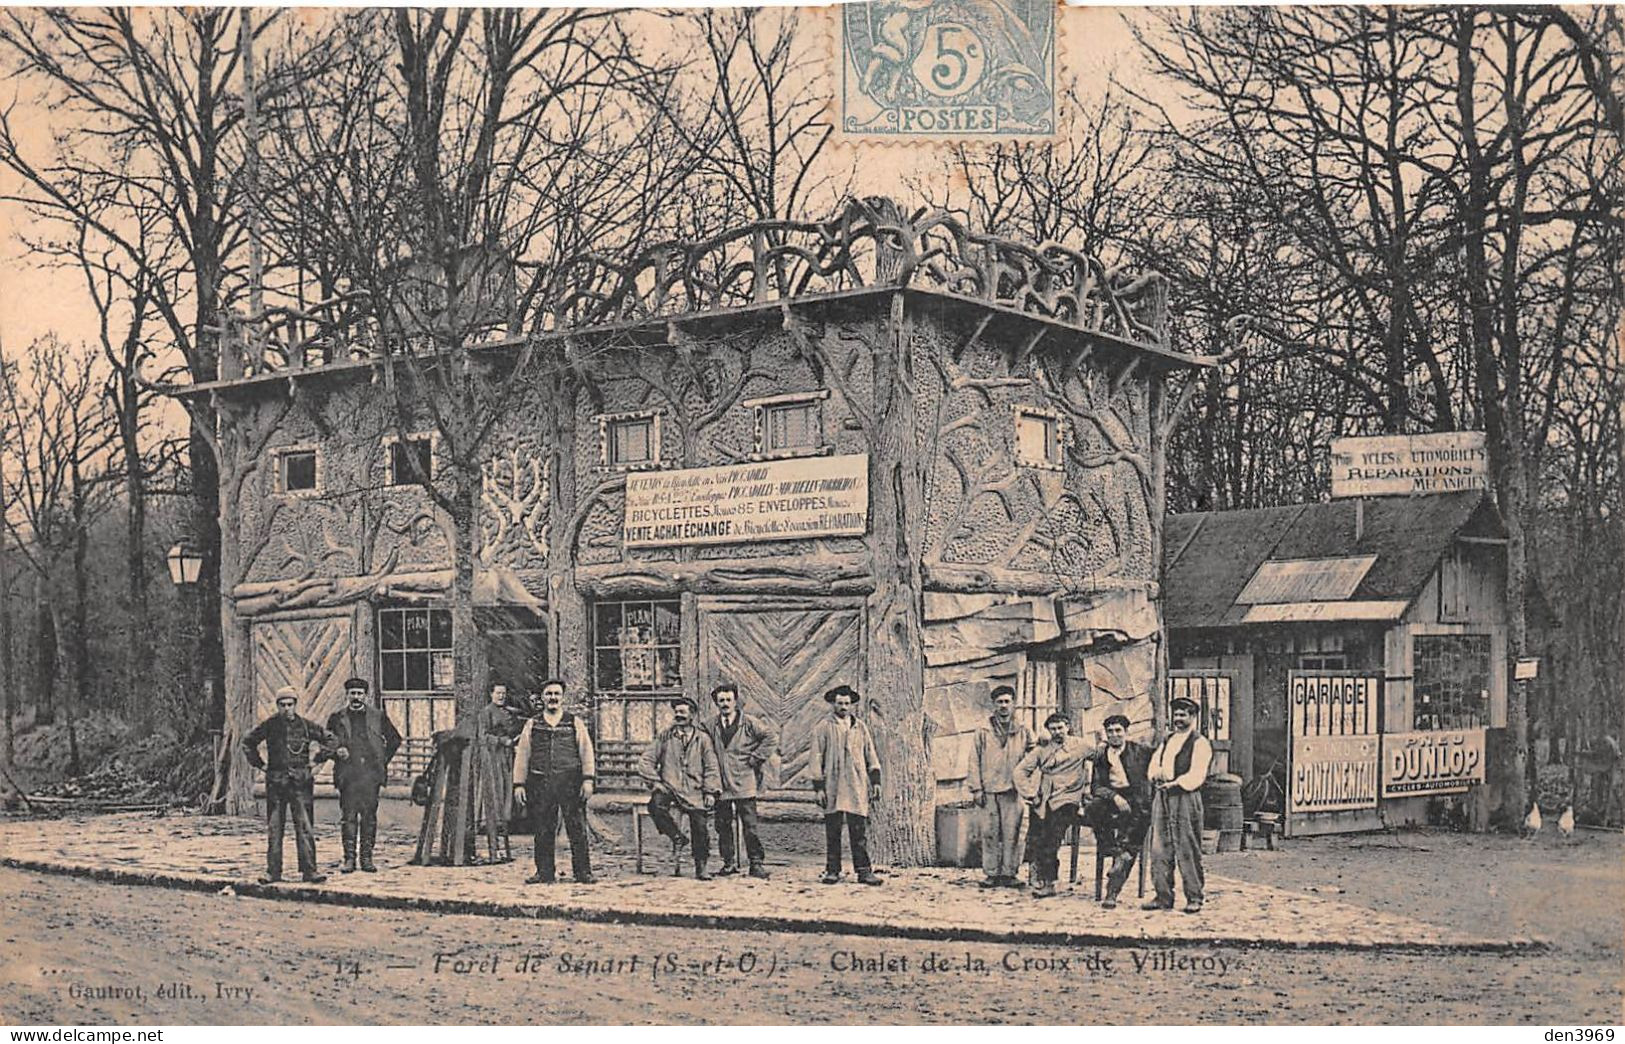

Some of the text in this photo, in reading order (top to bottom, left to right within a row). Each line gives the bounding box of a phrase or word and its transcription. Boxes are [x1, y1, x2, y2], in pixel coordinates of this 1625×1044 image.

[902, 108, 995, 131] POSTES
[1355, 450, 1395, 466] YCLES
[632, 504, 711, 522] BICYCLETTES
[759, 496, 827, 514] ENVELOPPES
[683, 519, 732, 538] ÉCHANGE
[1294, 683, 1365, 704] GARAGE
[1391, 747, 1479, 781] DUNLOP
[1293, 760, 1376, 806] CONTINENTAL
